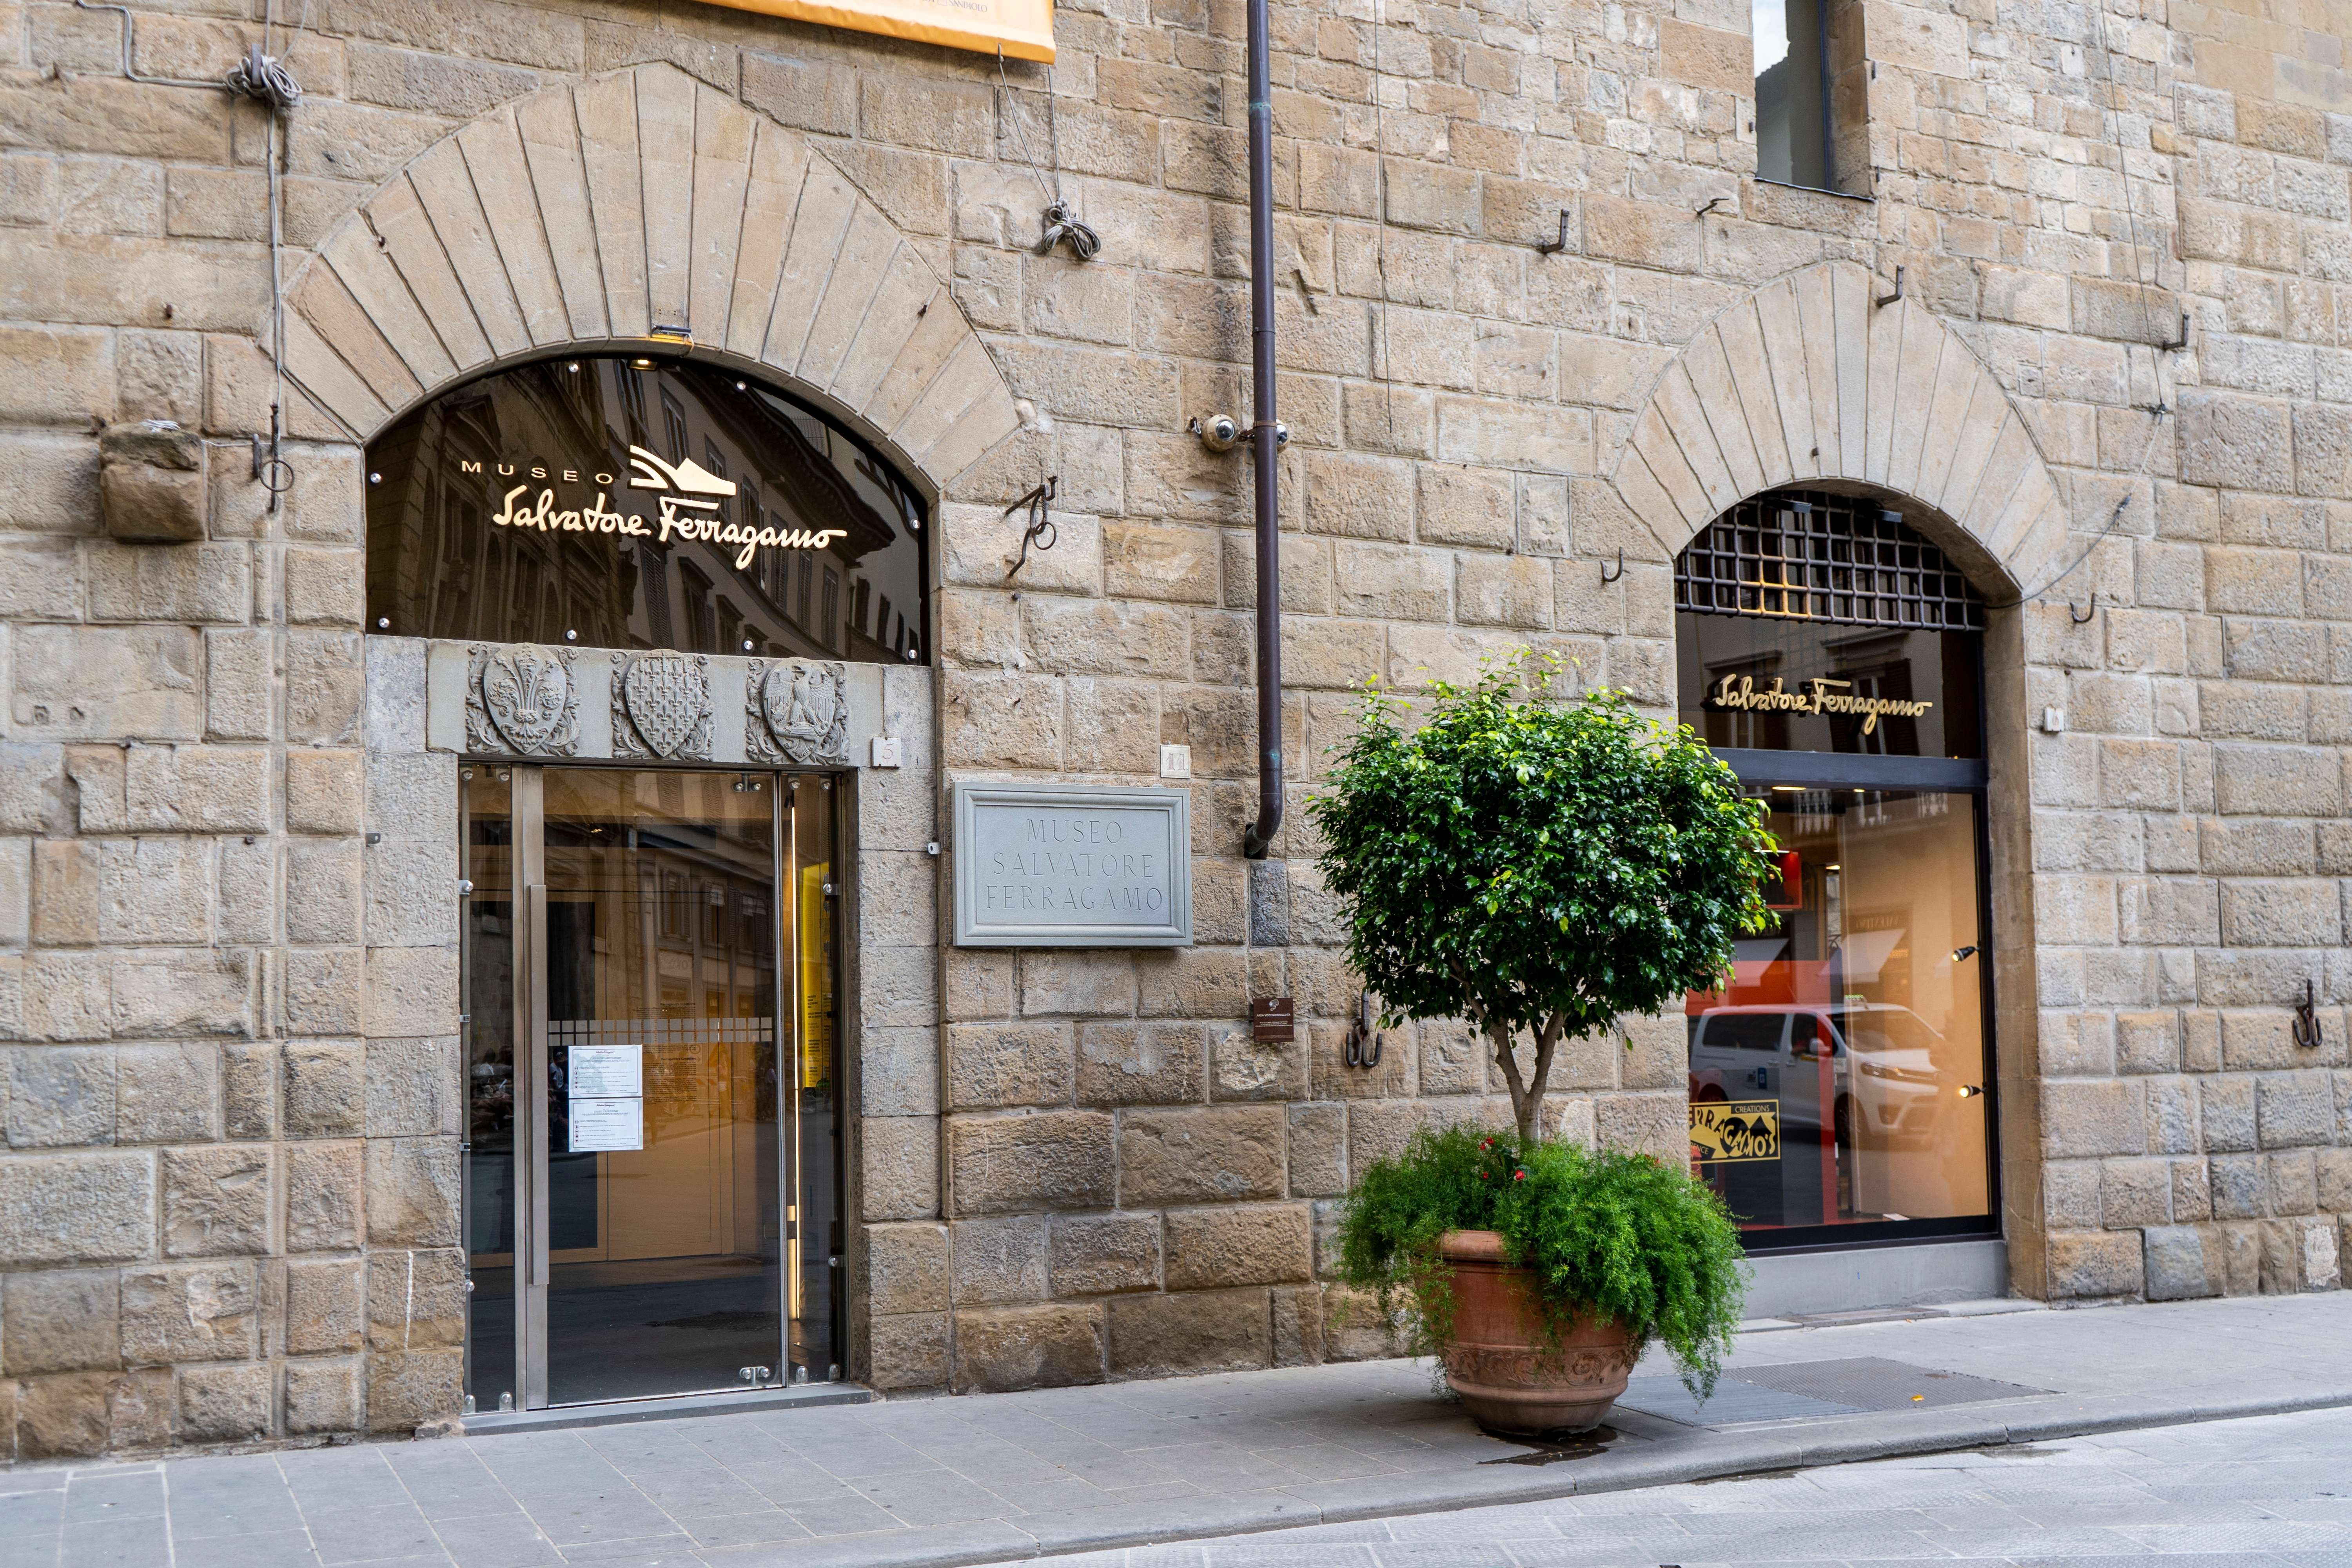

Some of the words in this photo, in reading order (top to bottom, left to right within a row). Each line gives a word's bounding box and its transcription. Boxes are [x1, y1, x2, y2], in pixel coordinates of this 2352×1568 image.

[461, 460, 613, 485] MUSEO
[492, 485, 652, 536] Salvatore
[657, 496, 848, 570] Ferragamo
[1715, 673, 1813, 712] Salvatore
[1810, 678, 1933, 735] Ferragamo
[882, 742, 894, 760] 5
[1166, 753, 1186, 771] 11
[1026, 818, 1122, 844] MUSEO
[993, 852, 1154, 878] SALVATORE
[985, 885, 1162, 911] FERRAGAMO
[1735, 1105, 1770, 1113] CREATIONS
[1689, 1107, 1775, 1157] ERRAGAMO'S
